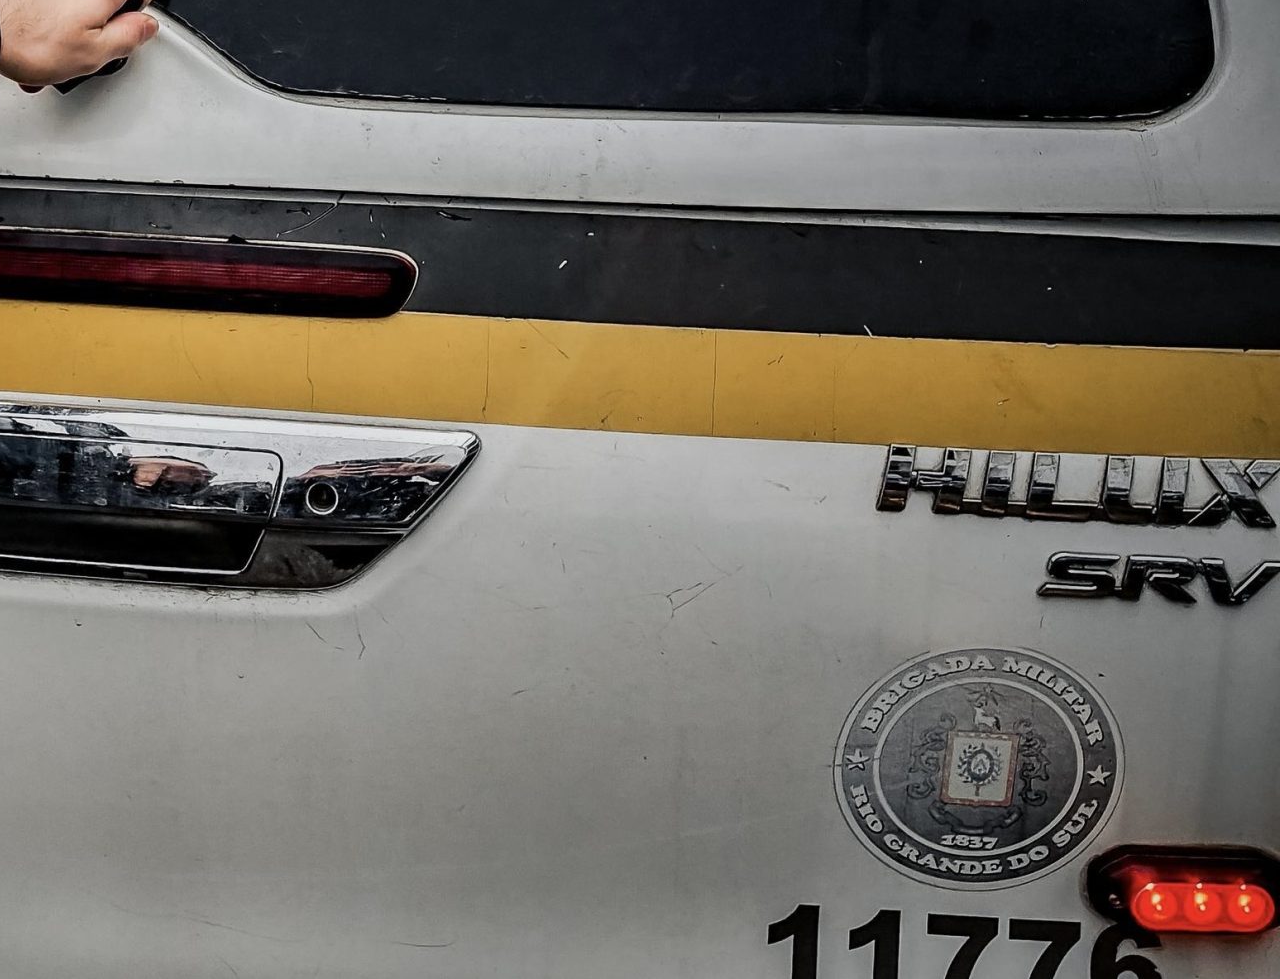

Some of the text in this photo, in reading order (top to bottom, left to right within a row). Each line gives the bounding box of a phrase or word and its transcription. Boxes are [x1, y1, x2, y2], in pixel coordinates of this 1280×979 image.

[875, 443, 1280, 527] HILUX
[1036, 551, 1280, 605] SRV
[860, 654, 1105, 746] BRIGADA MILITAR
[849, 783, 1099, 875] RIO GRANDE DO SUL
[939, 833, 999, 850] 1837
